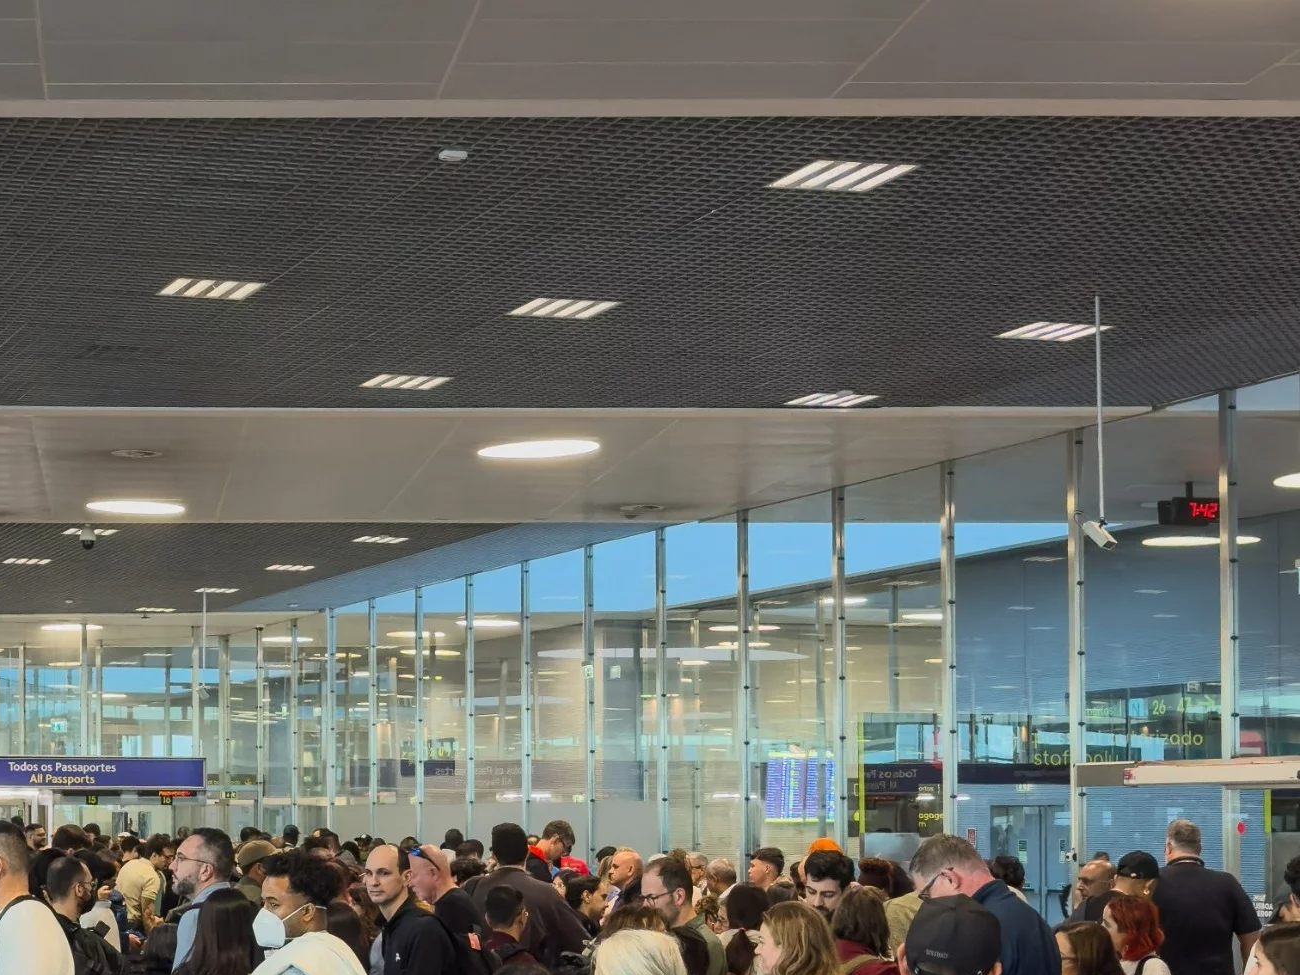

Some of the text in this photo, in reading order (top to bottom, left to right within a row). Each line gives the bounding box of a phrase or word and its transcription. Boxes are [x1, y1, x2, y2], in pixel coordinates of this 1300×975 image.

[1189, 501, 1219, 519] 7:42
[1152, 699, 1166, 715] 26
[1034, 750, 1071, 765] staf
[8, 761, 117, 774] Todos os Passaportes
[29, 774, 95, 785] All Passports
[87, 795, 97, 804] 15
[163, 796, 171, 804] 16
